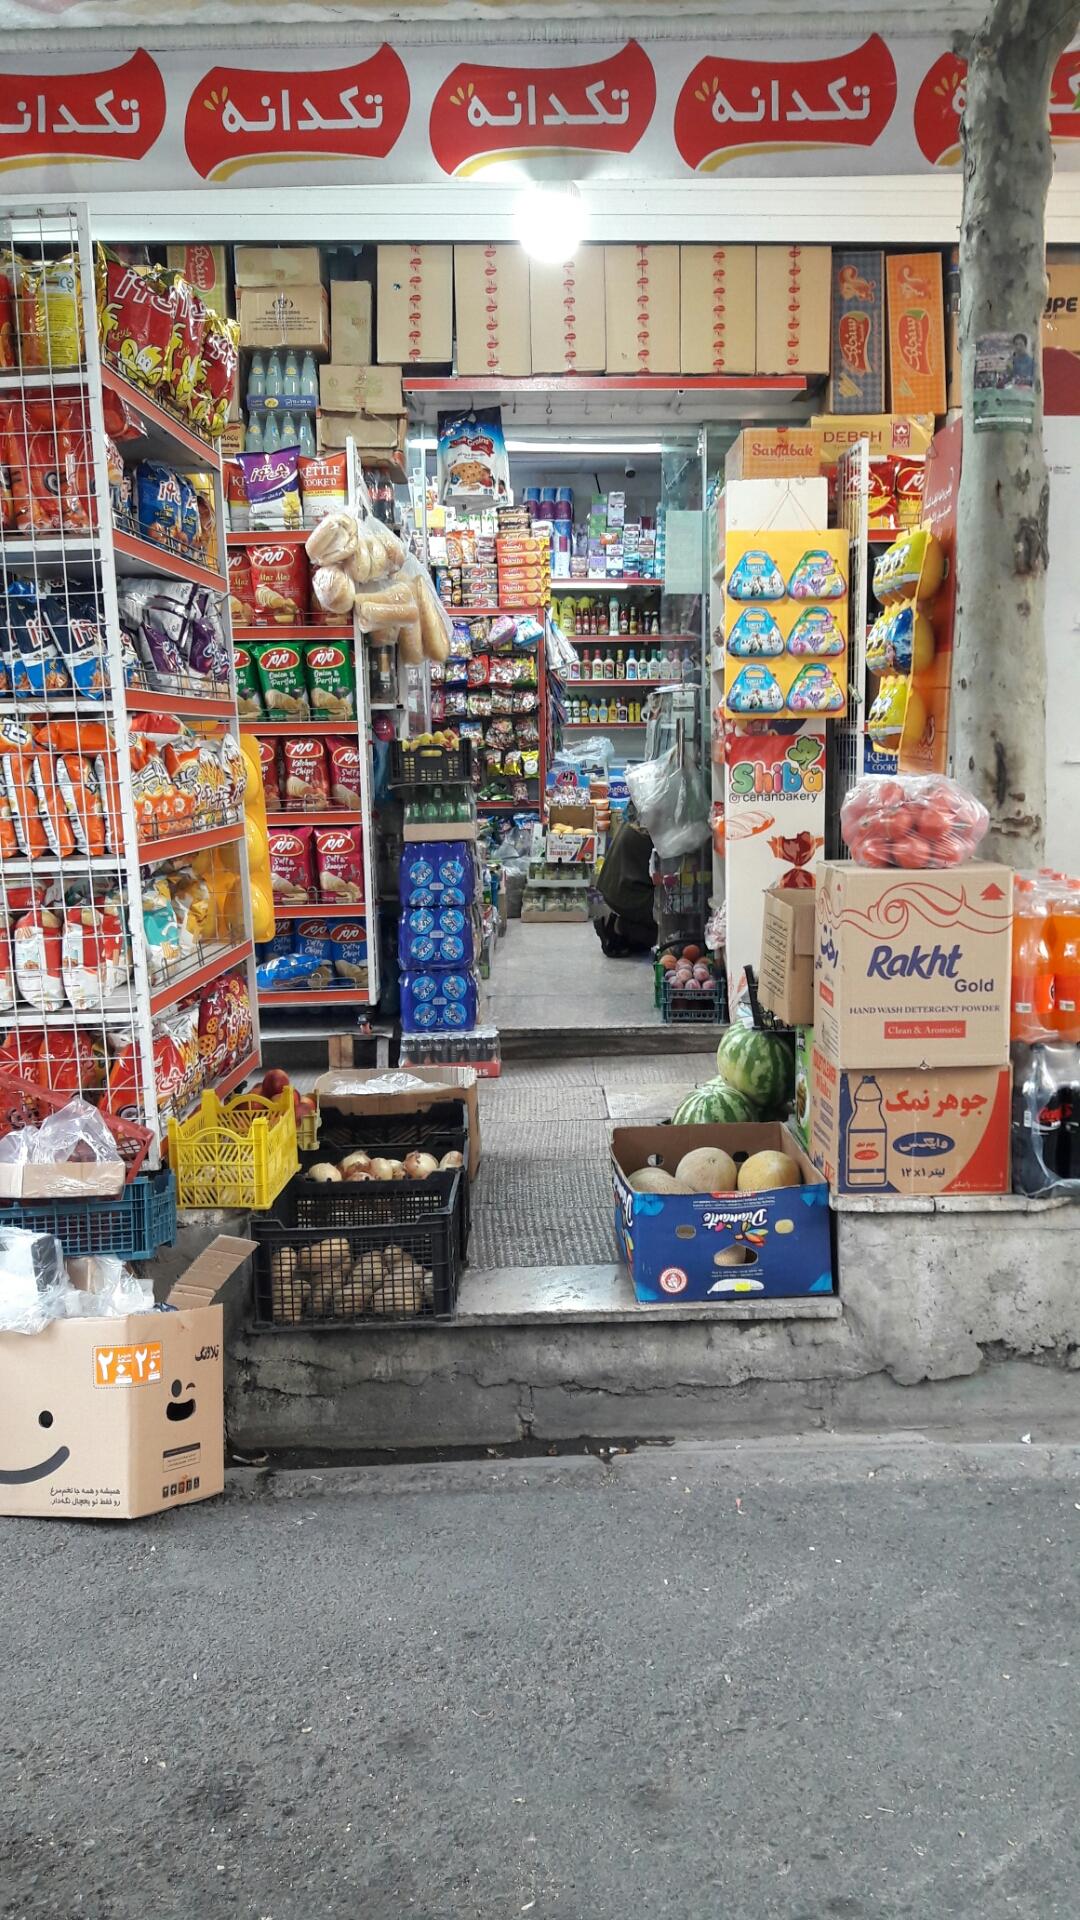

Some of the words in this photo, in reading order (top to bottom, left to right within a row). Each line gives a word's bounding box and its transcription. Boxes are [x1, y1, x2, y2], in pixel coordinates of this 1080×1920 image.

[467, 80, 630, 129] تکدانه
[711, 76, 871, 124] تکدانه
[0, 87, 140, 134] تکدان
[221, 86, 385, 133] تکدانه
[824, 431, 882, 443] DEBSH
[300, 465, 341, 479] KETTLE
[304, 478, 337, 487] COOKED
[867, 752, 896, 763] KETT
[731, 762, 824, 794] Shiba
[866, 944, 963, 980] Rakht
[954, 978, 994, 993] Gold
[904, 1006, 959, 1014] DETERGENT
[888, 1026, 912, 1034] Clean
[914, 1026, 921, 1034] &
[924, 1026, 961, 1034] Aromatic
[885, 1089, 930, 1113] نمک
[932, 1094, 988, 1118] جوهر
[900, 1137, 949, 1151] وایتکس
[928, 1166, 945, 1179] لیتر
[702, 1207, 768, 1230] Diamante
[74, 1488, 80, 1496] جا
[100, 1487, 120, 1495] همیشه
